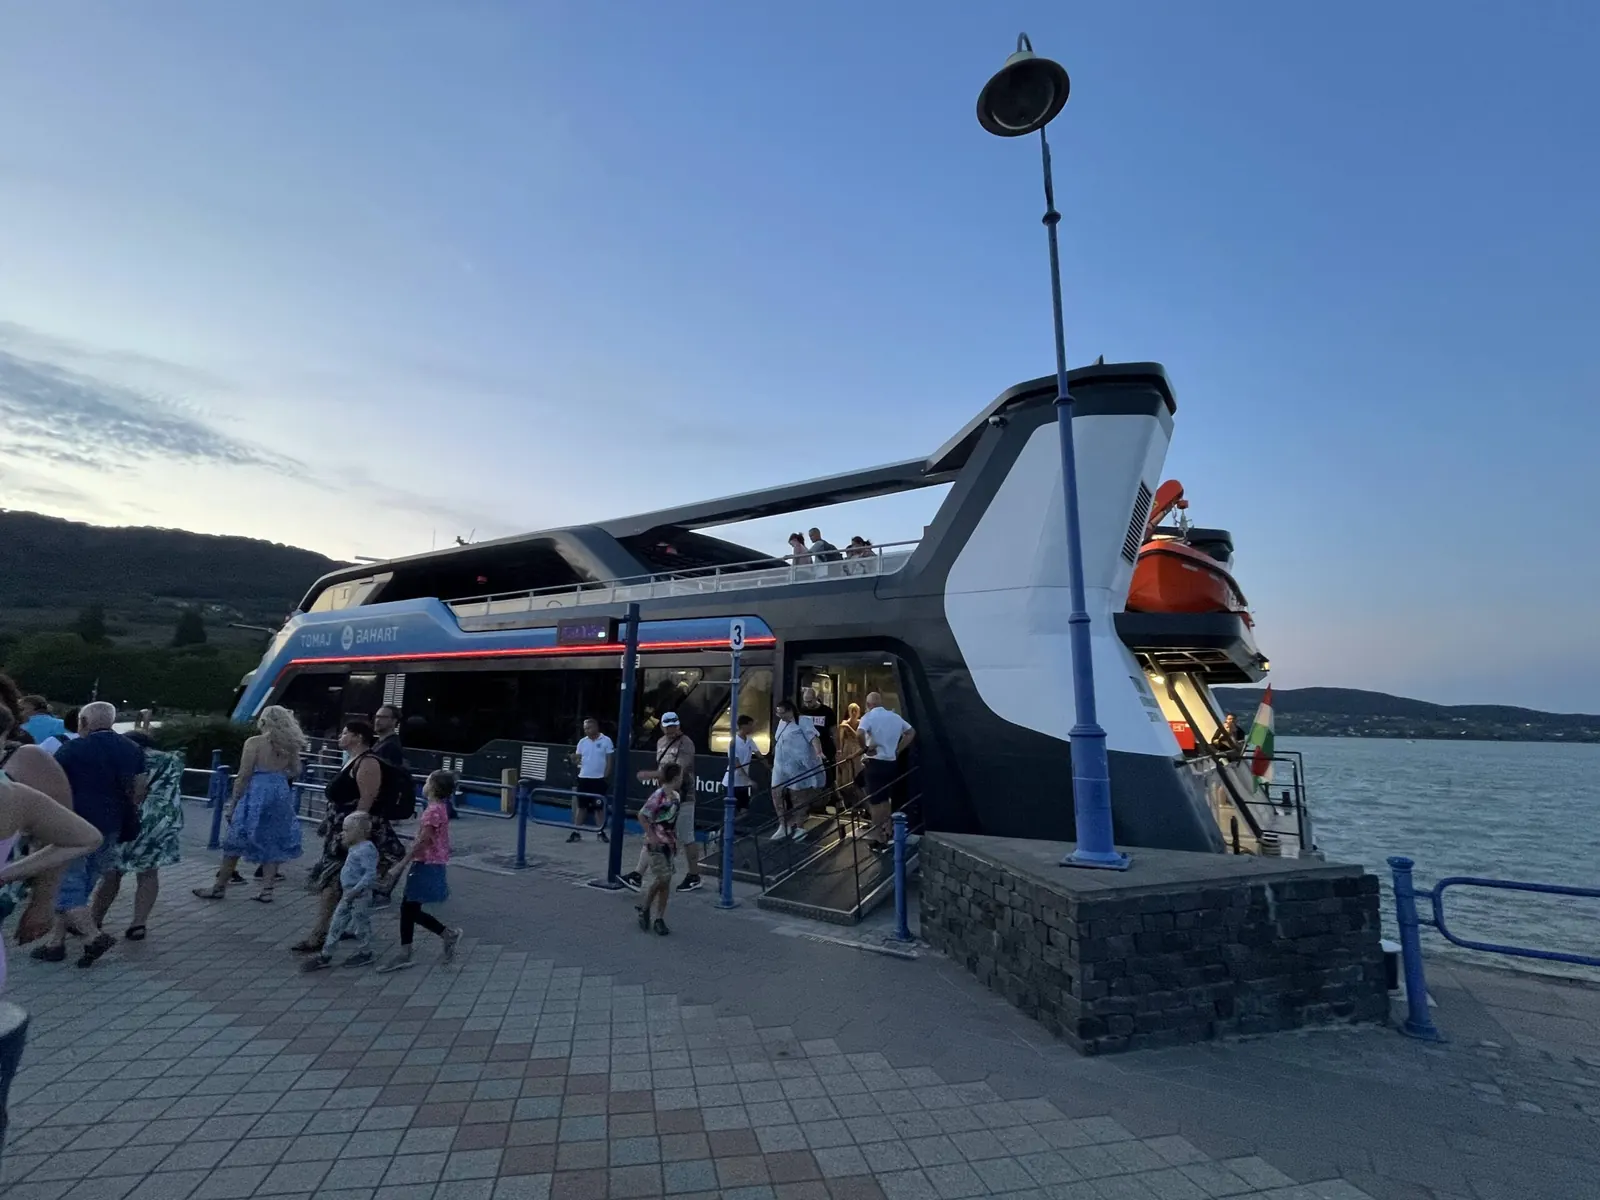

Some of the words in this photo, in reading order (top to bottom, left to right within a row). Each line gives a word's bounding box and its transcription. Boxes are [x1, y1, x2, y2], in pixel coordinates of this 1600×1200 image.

[301, 633, 332, 648] TOMAJ
[356, 626, 399, 644] BAHART
[733, 624, 742, 646] 3
